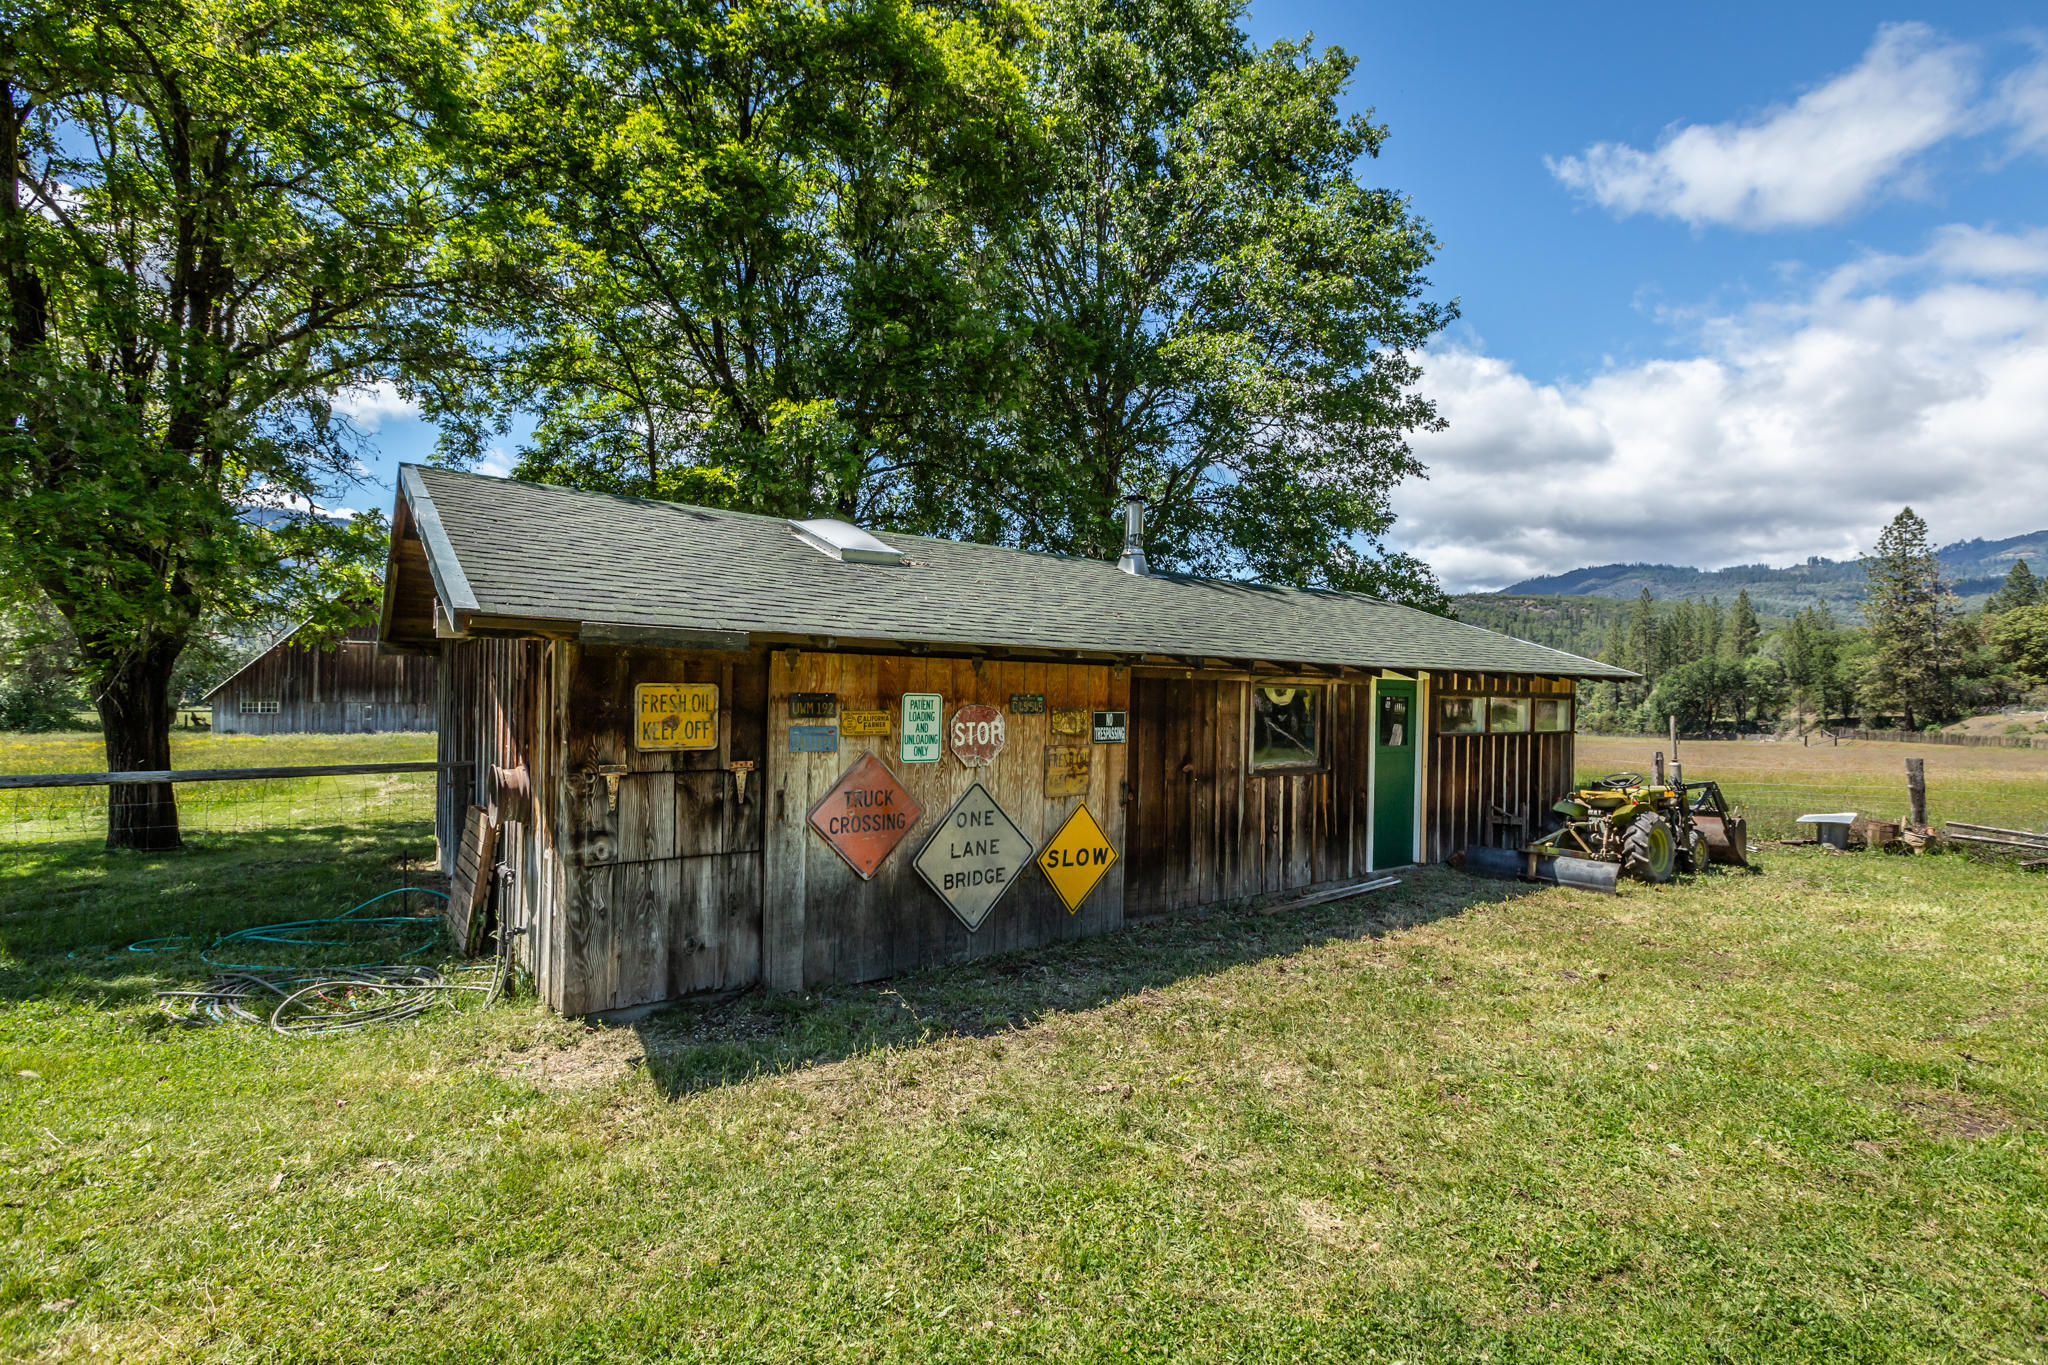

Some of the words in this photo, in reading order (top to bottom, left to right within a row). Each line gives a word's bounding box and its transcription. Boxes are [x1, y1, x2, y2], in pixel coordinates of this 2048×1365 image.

[641, 694, 687, 713] FRESH
[691, 693, 713, 713] OIL
[910, 699, 934, 711] PATIENT
[908, 711, 935, 722] LOADING
[642, 721, 679, 741] KEEP
[684, 720, 711, 739] OFF
[915, 723, 929, 733] AND
[954, 721, 1002, 746] STOP
[904, 734, 939, 745] UNLOADING
[913, 745, 929, 757] ONLY
[844, 789, 894, 809] TRUCK
[829, 812, 906, 835] CROSSING
[956, 810, 995, 829] ONE
[950, 838, 1000, 859] LANE
[1046, 847, 1109, 869] SLOW
[943, 867, 1006, 891] BRIDGE
